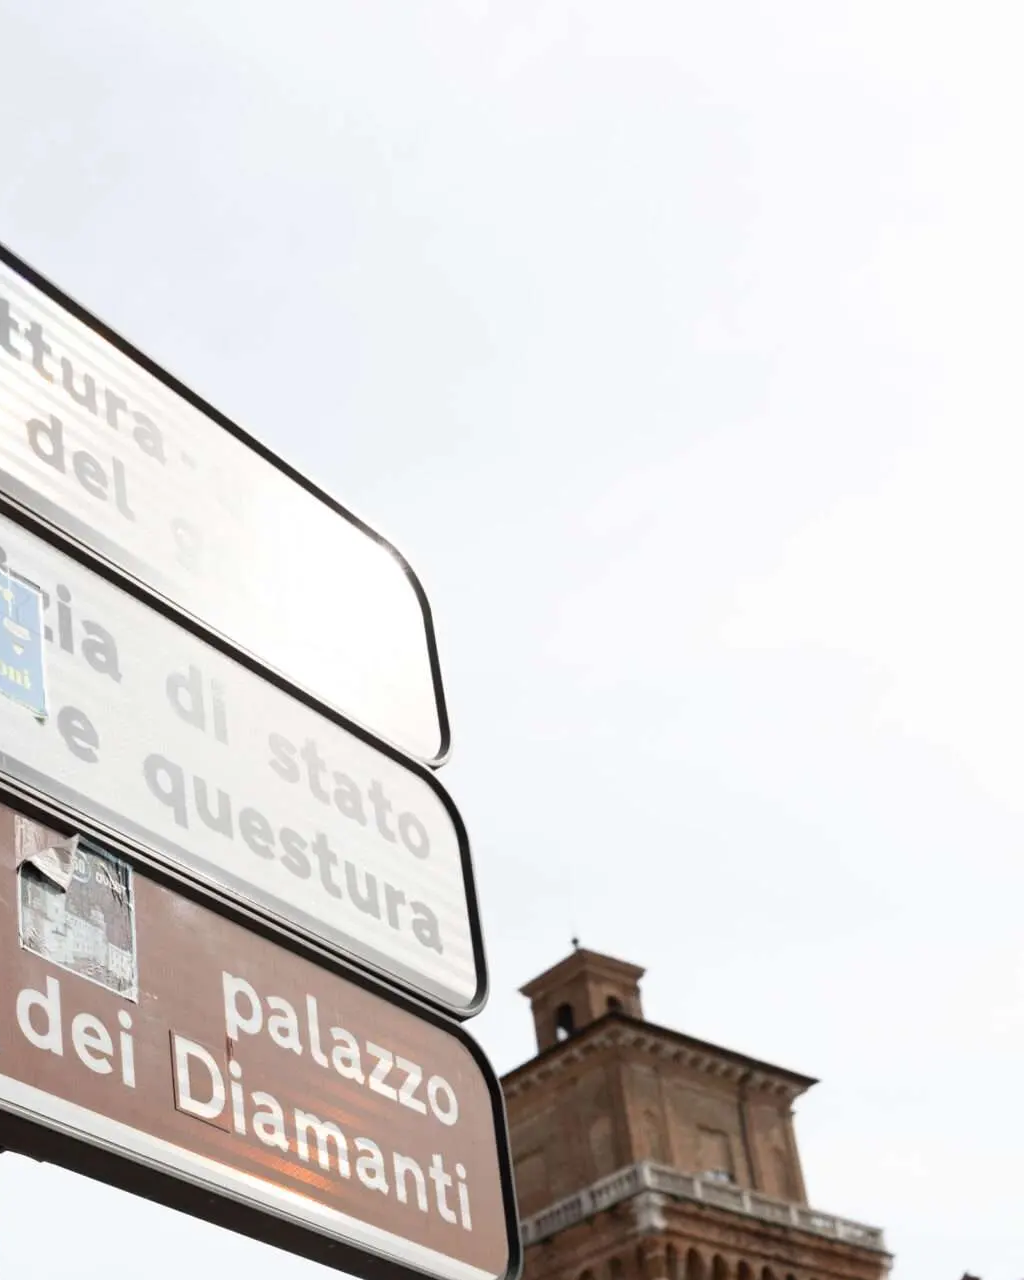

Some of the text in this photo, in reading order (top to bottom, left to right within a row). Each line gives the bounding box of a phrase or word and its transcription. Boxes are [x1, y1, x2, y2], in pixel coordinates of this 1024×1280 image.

[26, 413, 135, 522] del
[57, 705, 443, 955] e questura
[165, 663, 230, 747] di
[268, 732, 431, 861] stato
[16, 975, 473, 1232] dei Diamanti
[222, 971, 459, 1127] palazzo
